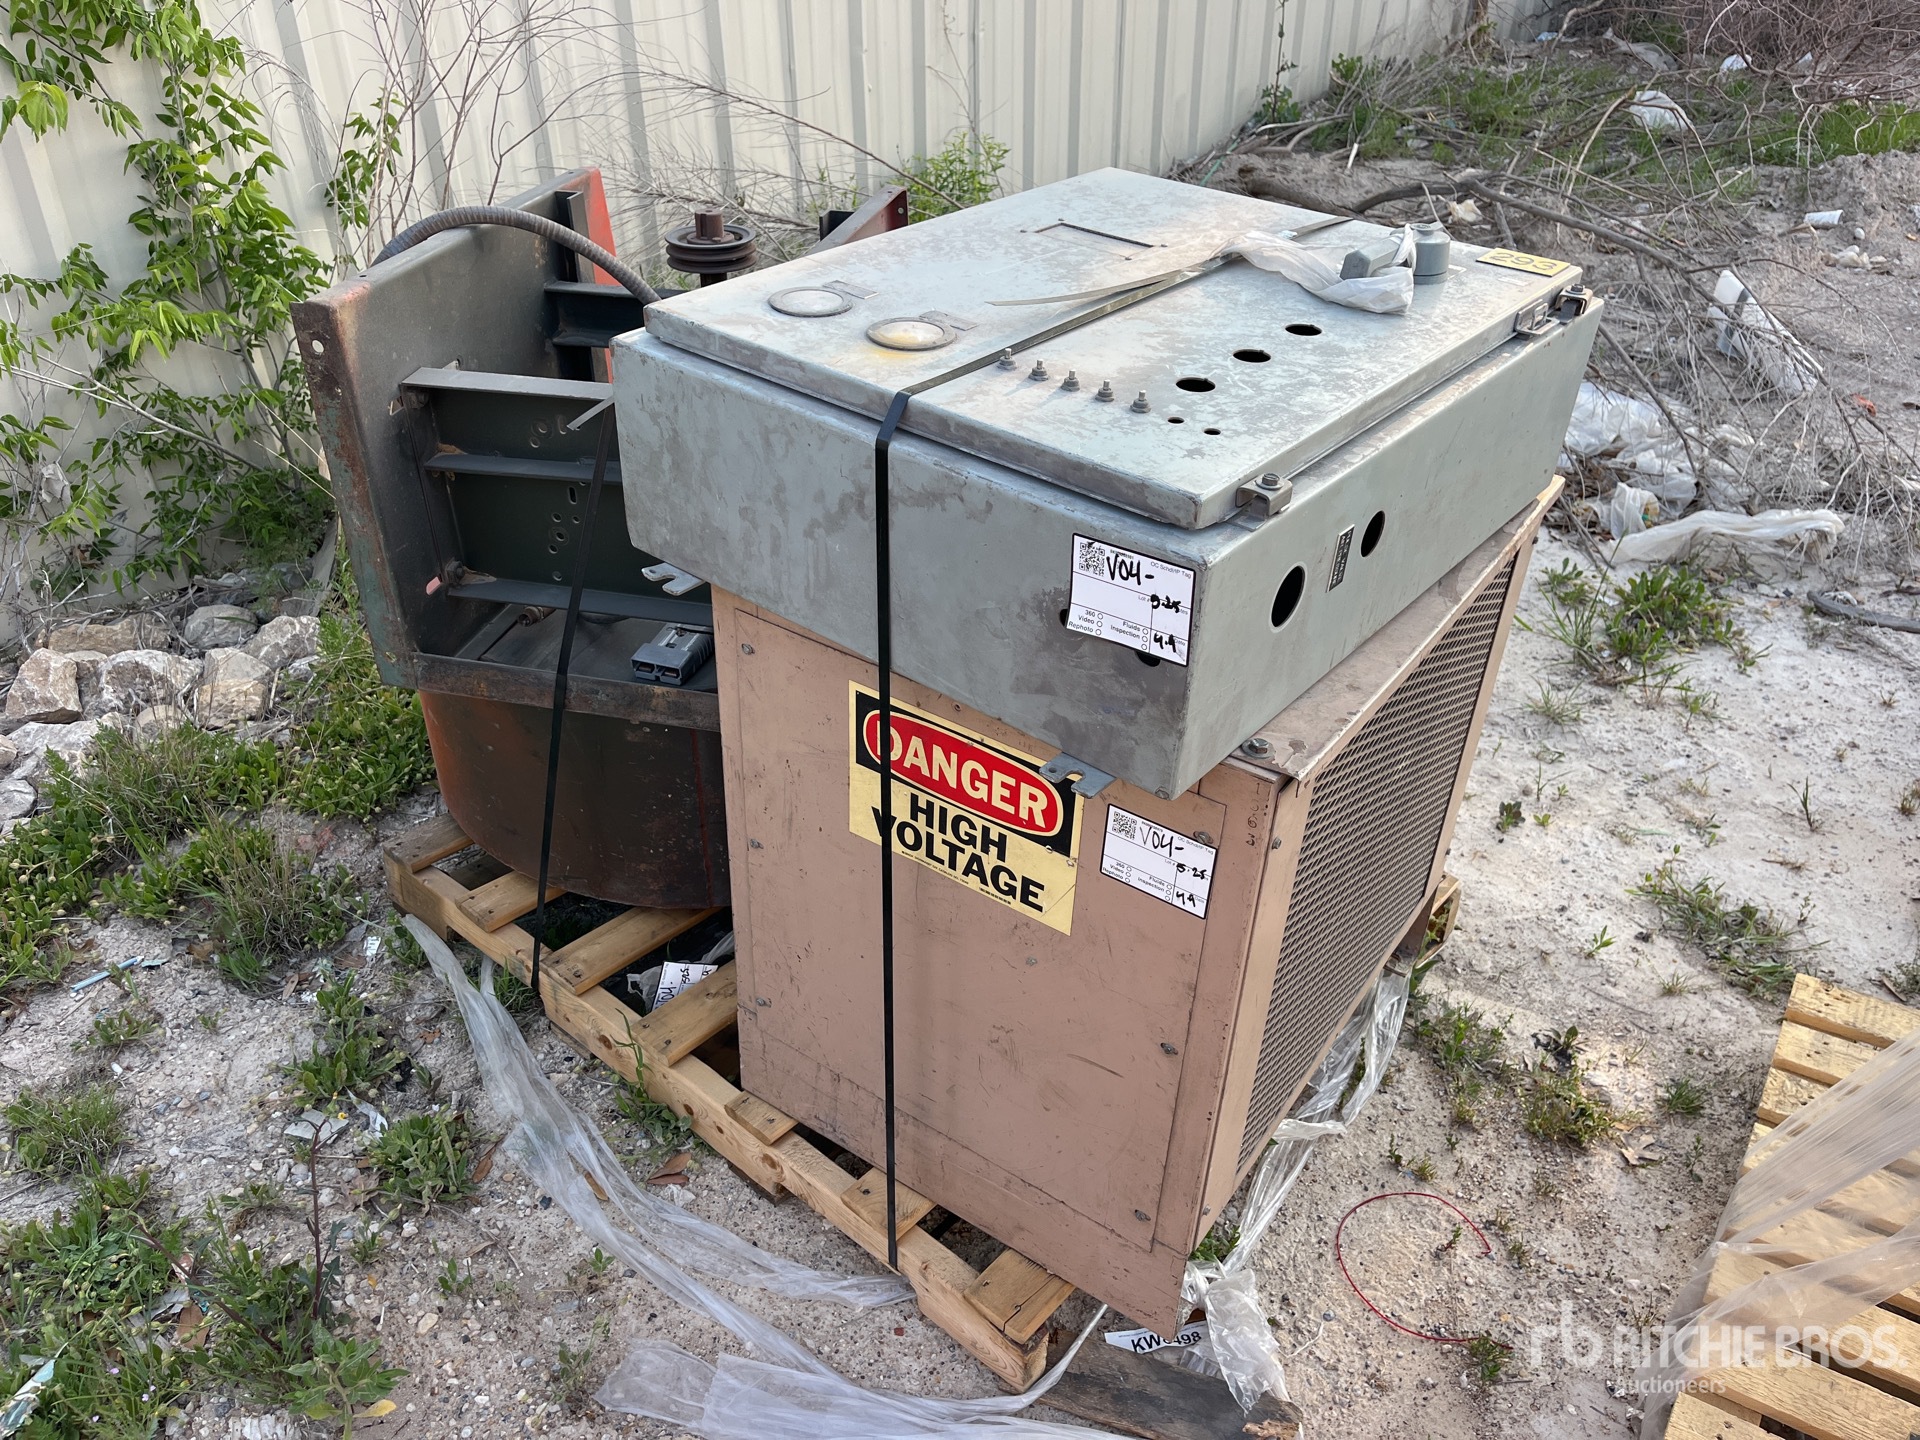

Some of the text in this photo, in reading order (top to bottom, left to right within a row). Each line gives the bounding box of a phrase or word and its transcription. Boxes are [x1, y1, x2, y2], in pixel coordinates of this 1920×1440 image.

[1489, 252, 1557, 271] 293
[1182, 570, 1192, 580] Tag
[1078, 615, 1094, 624] Video
[1085, 610, 1096, 618] 360
[1068, 621, 1093, 633] Rephoto
[1110, 625, 1140, 639] Inspection
[1122, 621, 1140, 632] Fluids
[876, 720, 1048, 829] DANGER
[910, 793, 1007, 862] HIGH
[871, 806, 1046, 912] VOLTAGE
[1102, 868, 1124, 880] Rephoto
[1110, 864, 1124, 874] Video
[1138, 877, 1165, 892] Inspection
[1149, 876, 1165, 887] Fluids
[1131, 1331, 1202, 1354] KW498
